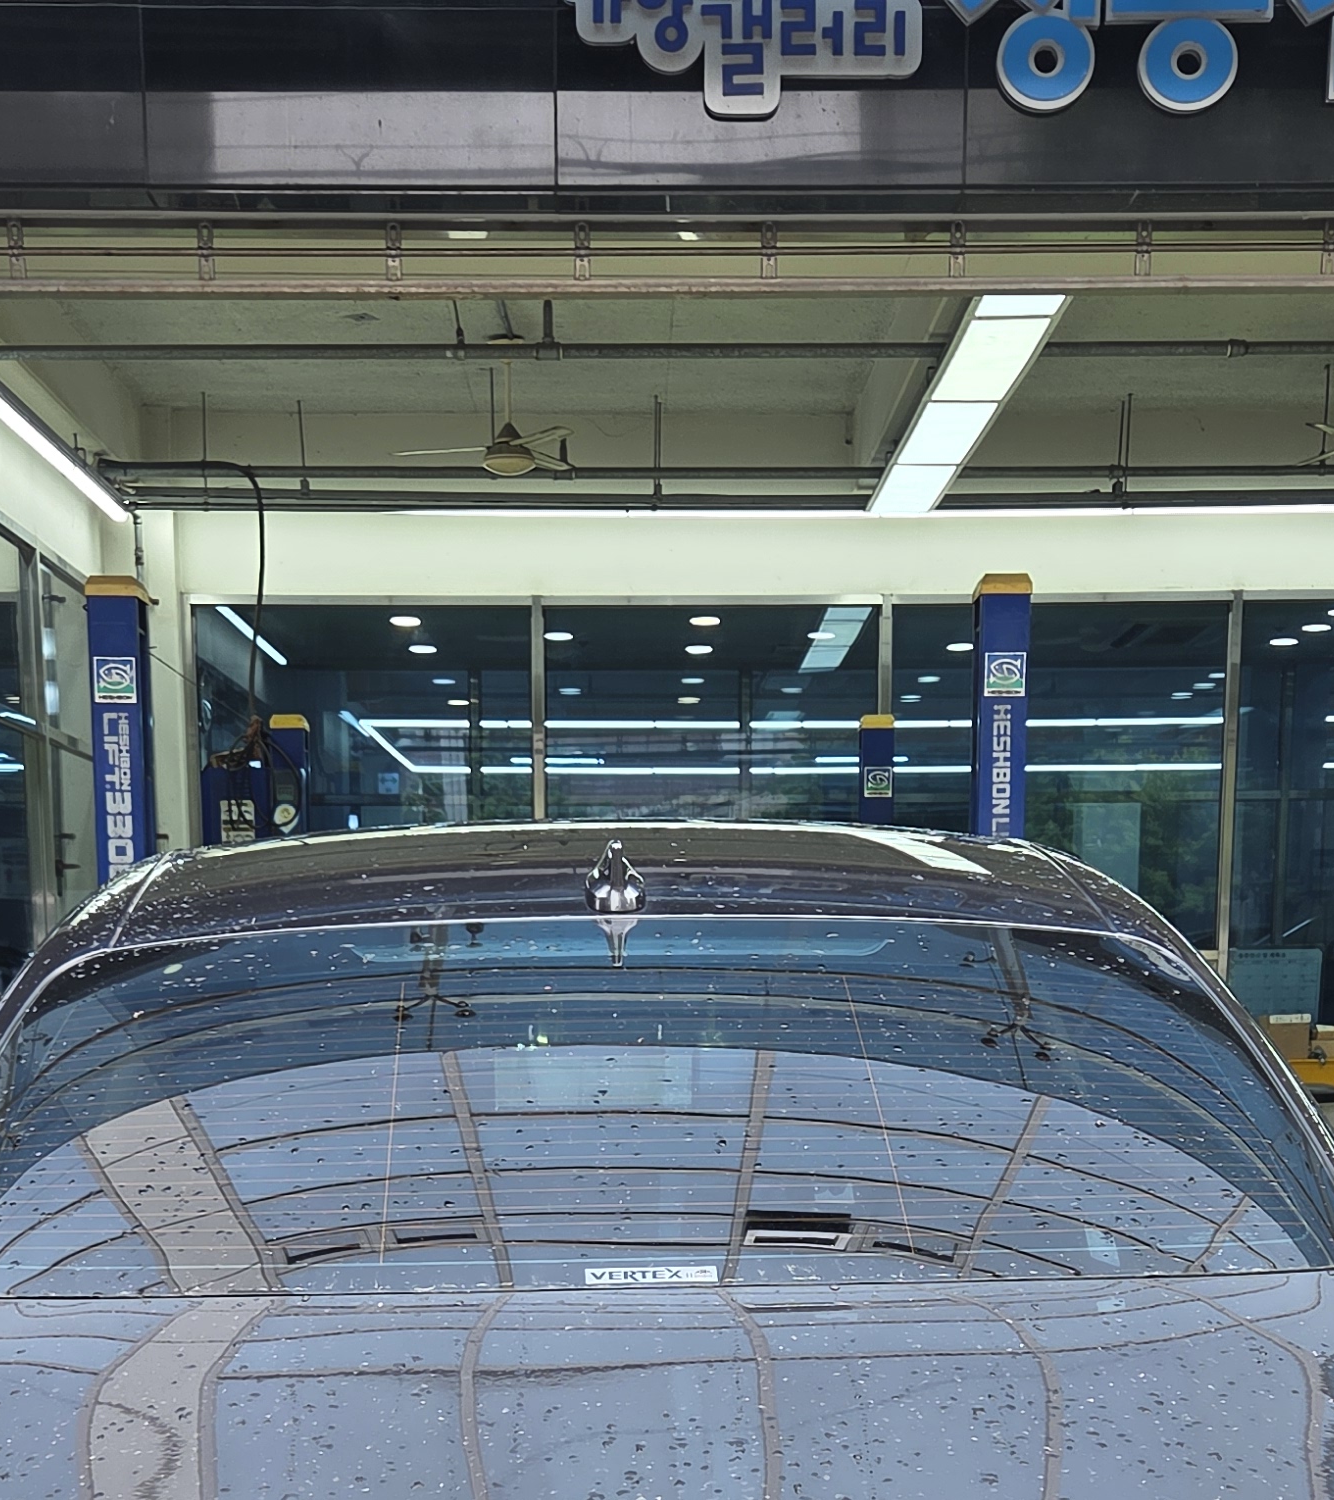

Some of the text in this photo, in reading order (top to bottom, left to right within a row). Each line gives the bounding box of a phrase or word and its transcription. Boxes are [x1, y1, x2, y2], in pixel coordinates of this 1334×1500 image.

[593, 0, 906, 96] 갤러리
[118, 712, 132, 791] HESHBON
[992, 704, 1012, 815] HESHBON
[591, 1267, 683, 1282] VERTEX
